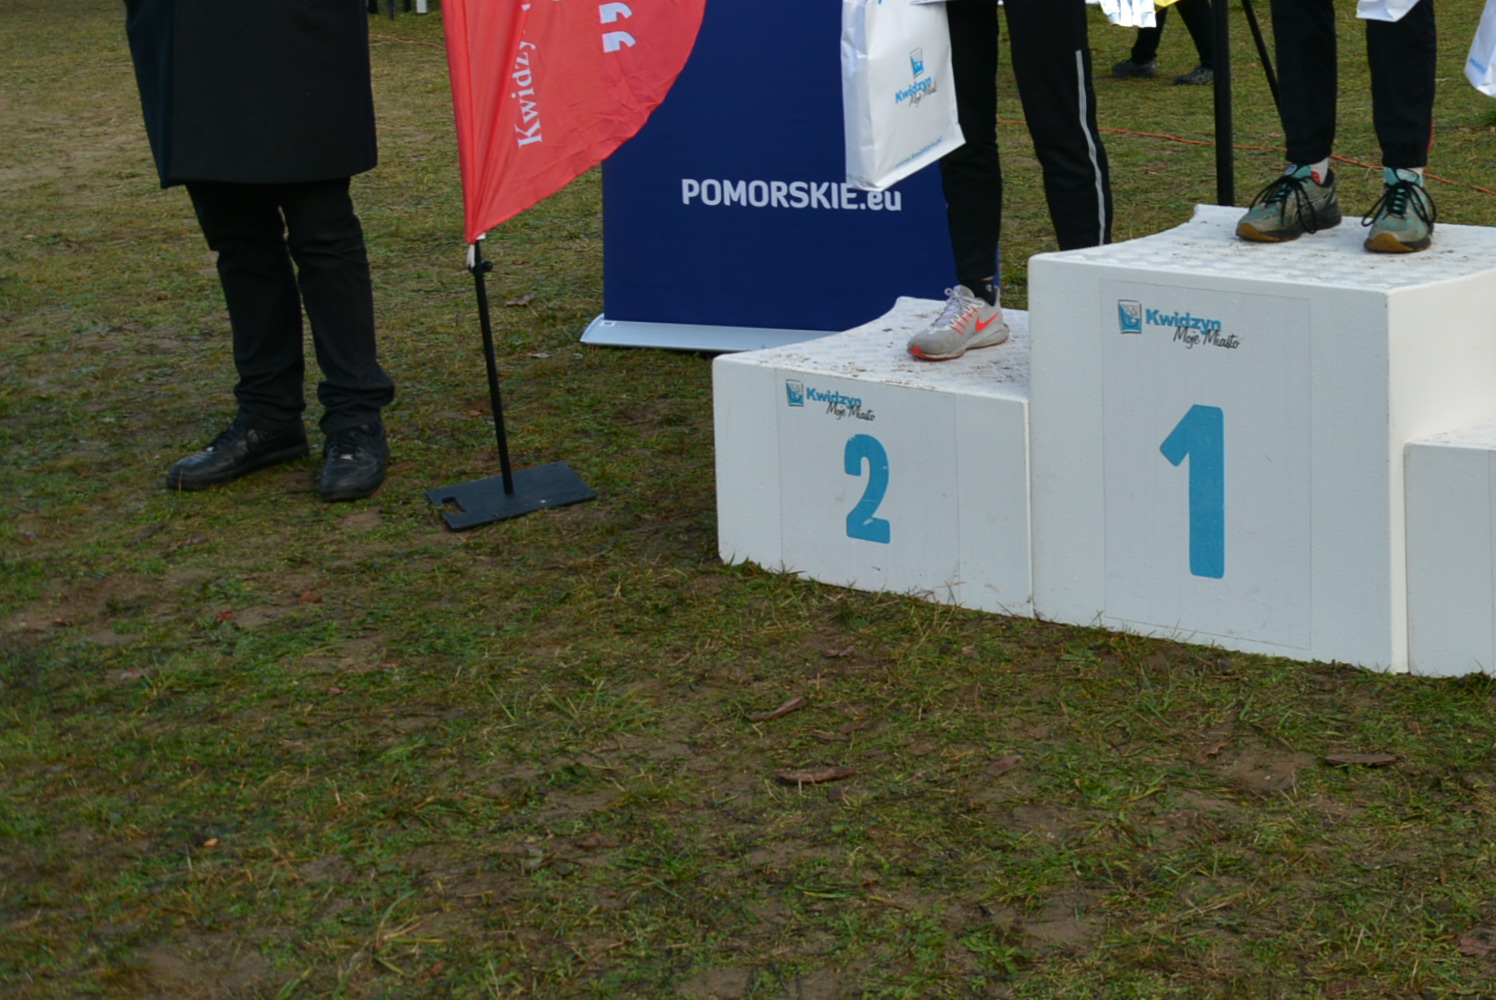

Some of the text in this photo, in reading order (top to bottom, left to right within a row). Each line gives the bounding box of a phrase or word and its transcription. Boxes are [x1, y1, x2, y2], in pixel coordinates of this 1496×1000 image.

[895, 76, 933, 104] Kwidzyn
[681, 178, 902, 211] POMORSKIE.eu
[1145, 308, 1222, 335] Kwidzyn
[806, 387, 862, 409] Kwidzyn
[844, 433, 891, 544] 2
[1160, 403, 1226, 579] 1
